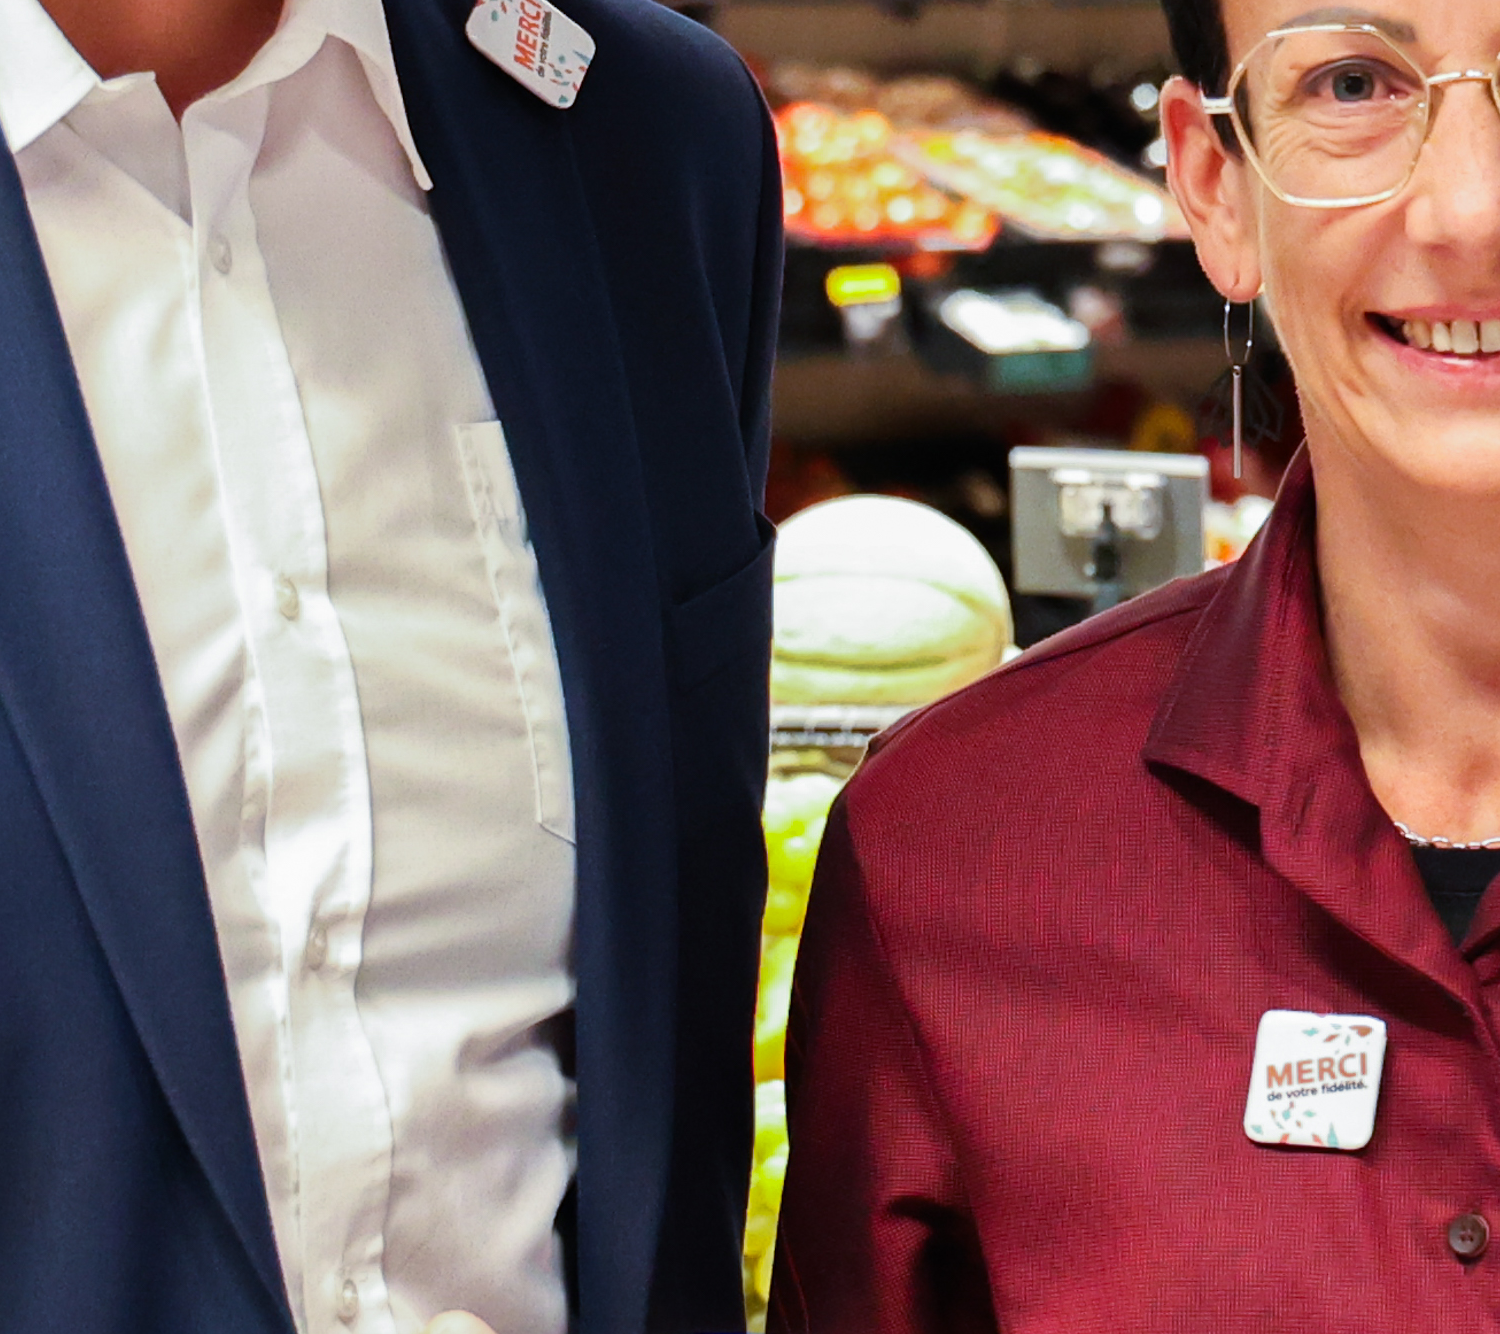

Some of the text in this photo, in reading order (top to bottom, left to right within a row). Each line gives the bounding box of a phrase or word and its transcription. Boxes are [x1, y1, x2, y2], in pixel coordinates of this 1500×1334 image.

[1266, 1052, 1368, 1089] MERCI
[1267, 1088, 1282, 1102] de
[1286, 1087, 1318, 1099] votre
